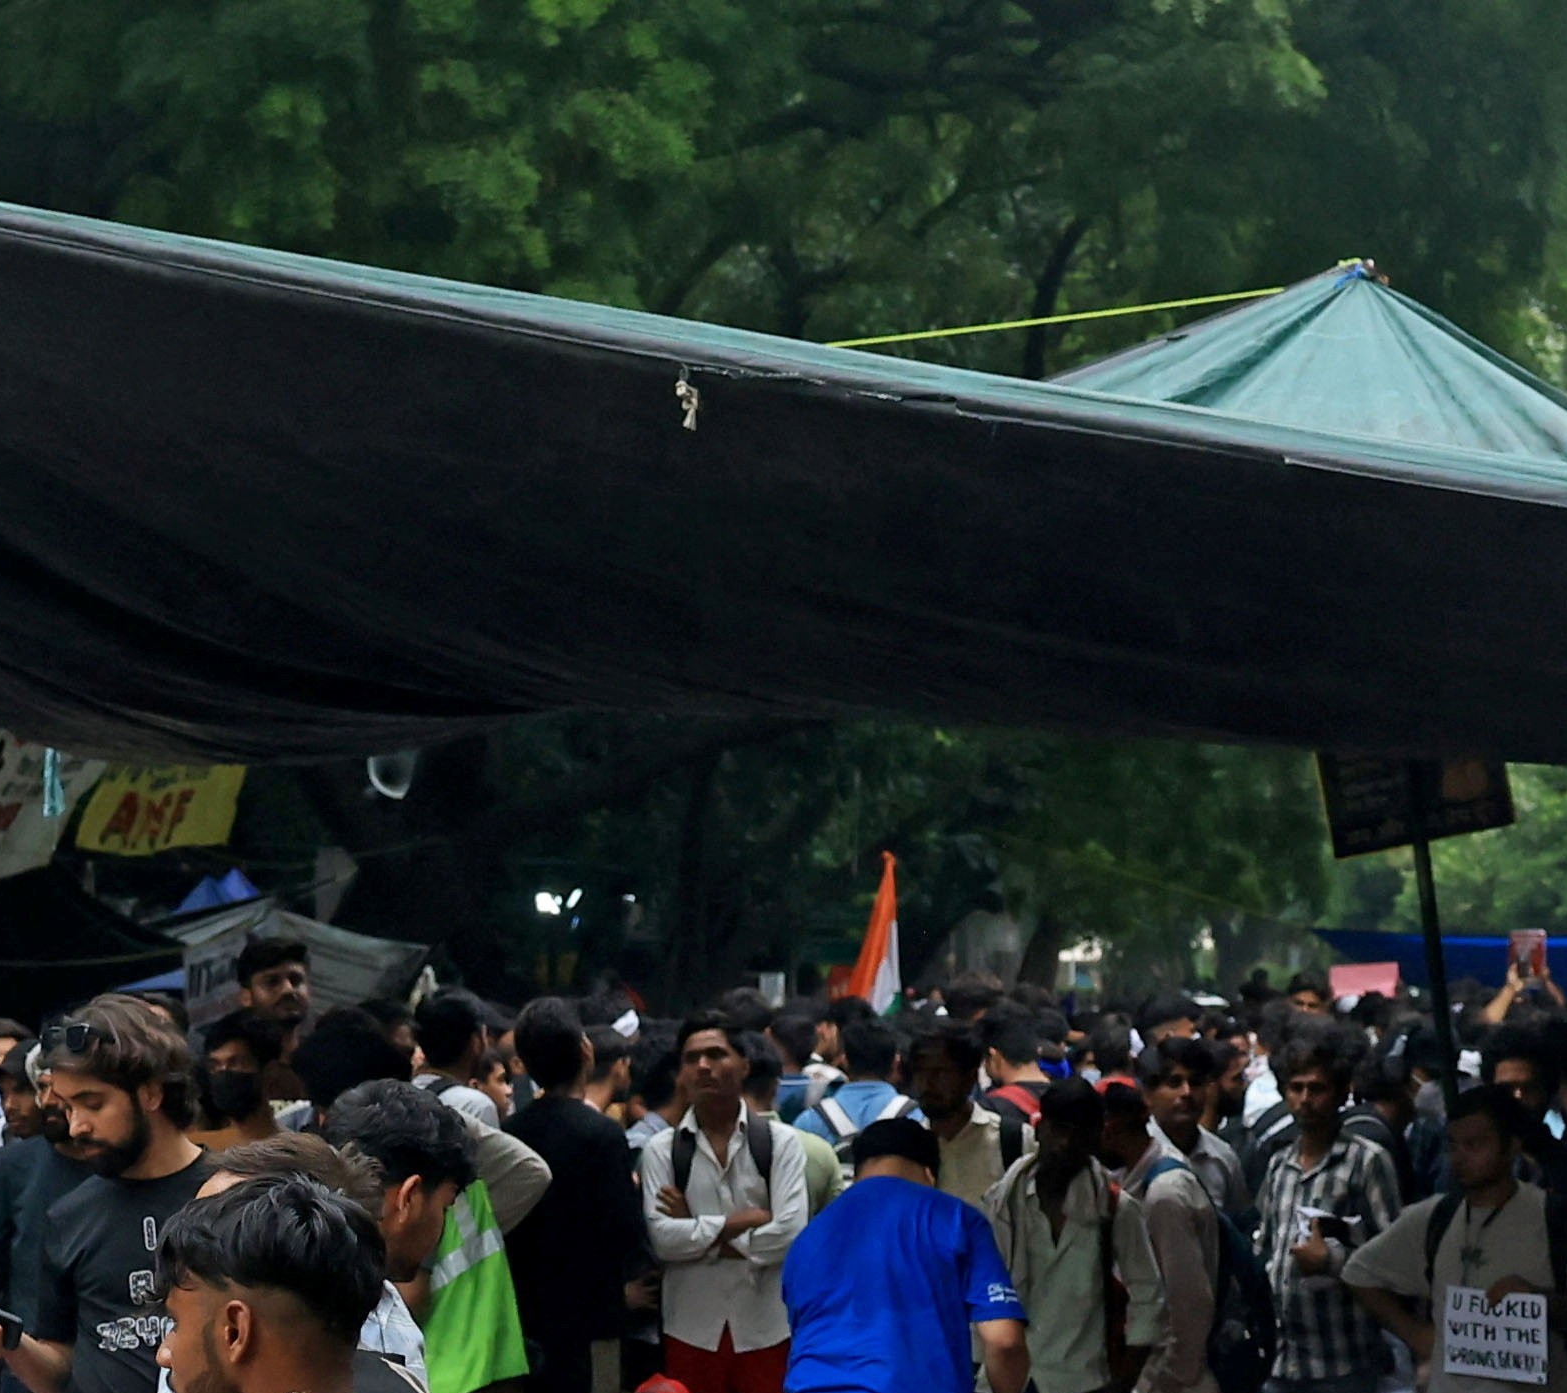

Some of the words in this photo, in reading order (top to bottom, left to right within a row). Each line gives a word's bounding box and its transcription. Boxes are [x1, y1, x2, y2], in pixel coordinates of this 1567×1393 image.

[1453, 1292, 1463, 1311] U
[1468, 1295, 1542, 1320] FUCKED
[1448, 1319, 1496, 1341] WITH
[1503, 1326, 1541, 1345] THE
